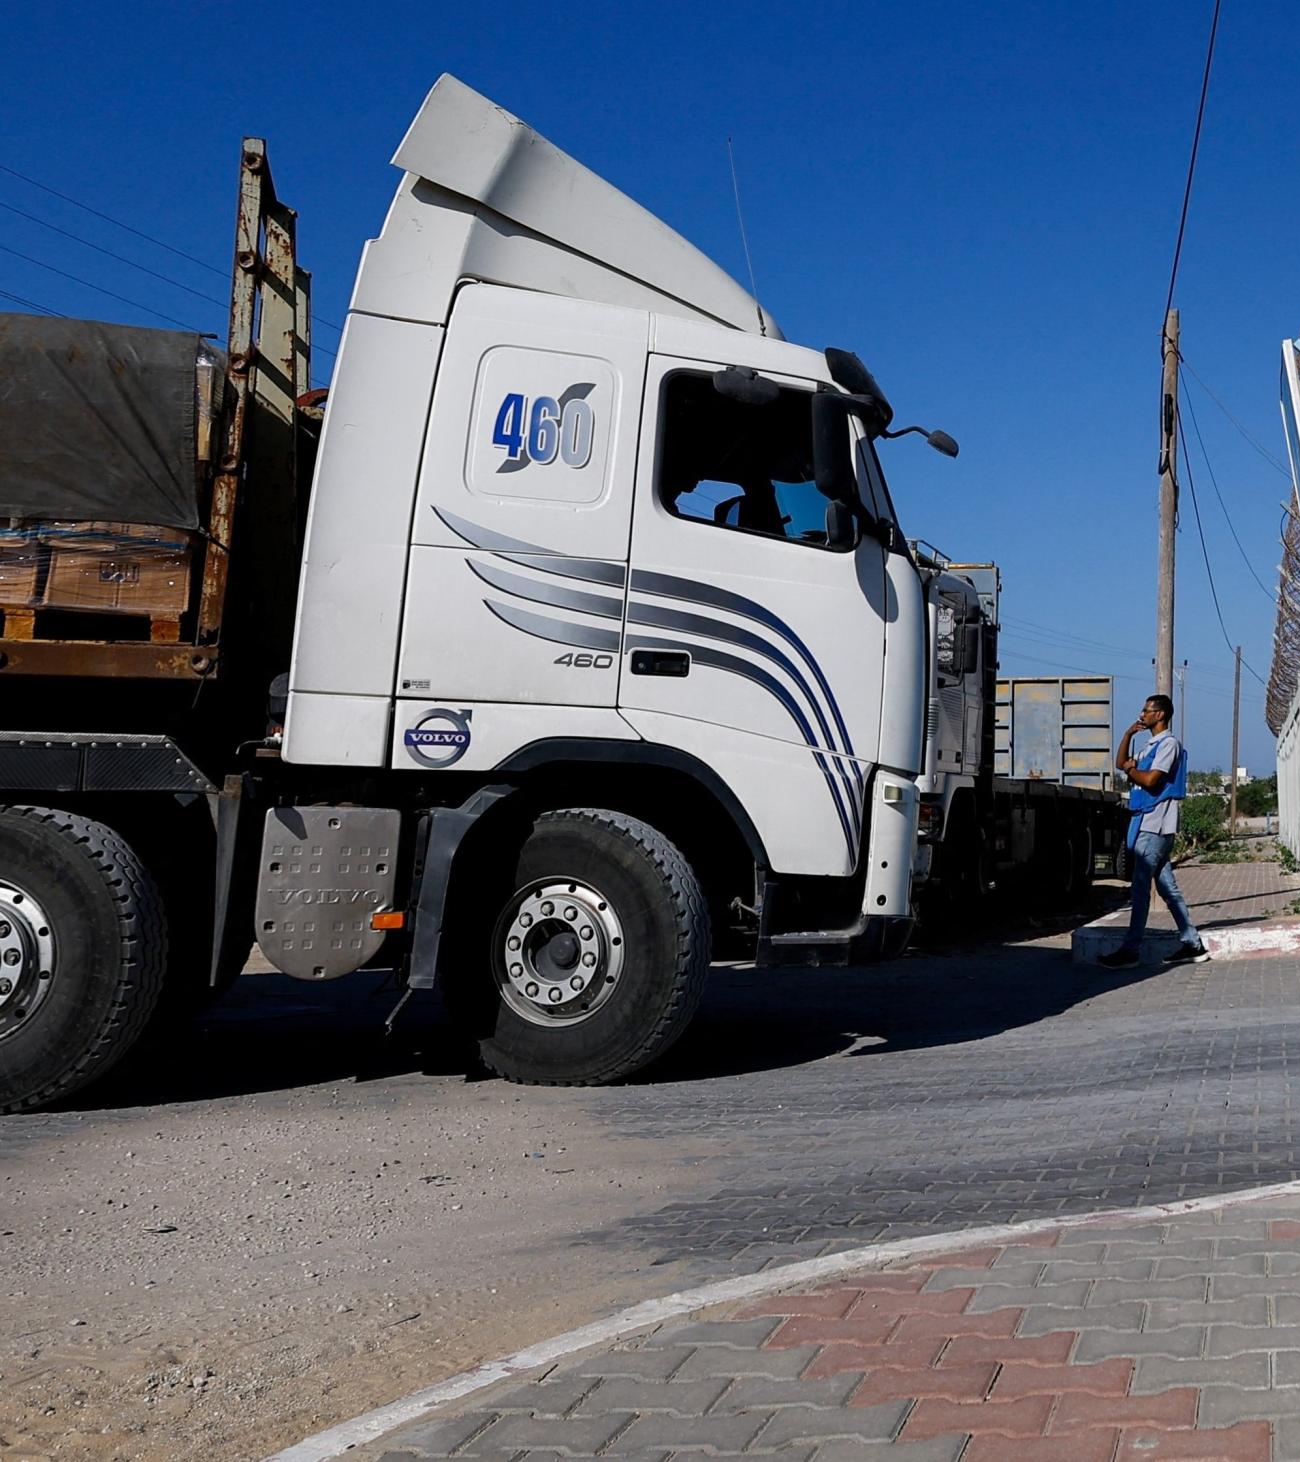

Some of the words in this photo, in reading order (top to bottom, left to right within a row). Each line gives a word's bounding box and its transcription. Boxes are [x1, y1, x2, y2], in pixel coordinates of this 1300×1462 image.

[491, 392, 595, 470] 460
[553, 652, 614, 669] 460
[409, 732, 466, 743] VOLVO
[267, 888, 385, 905] VOLVO
